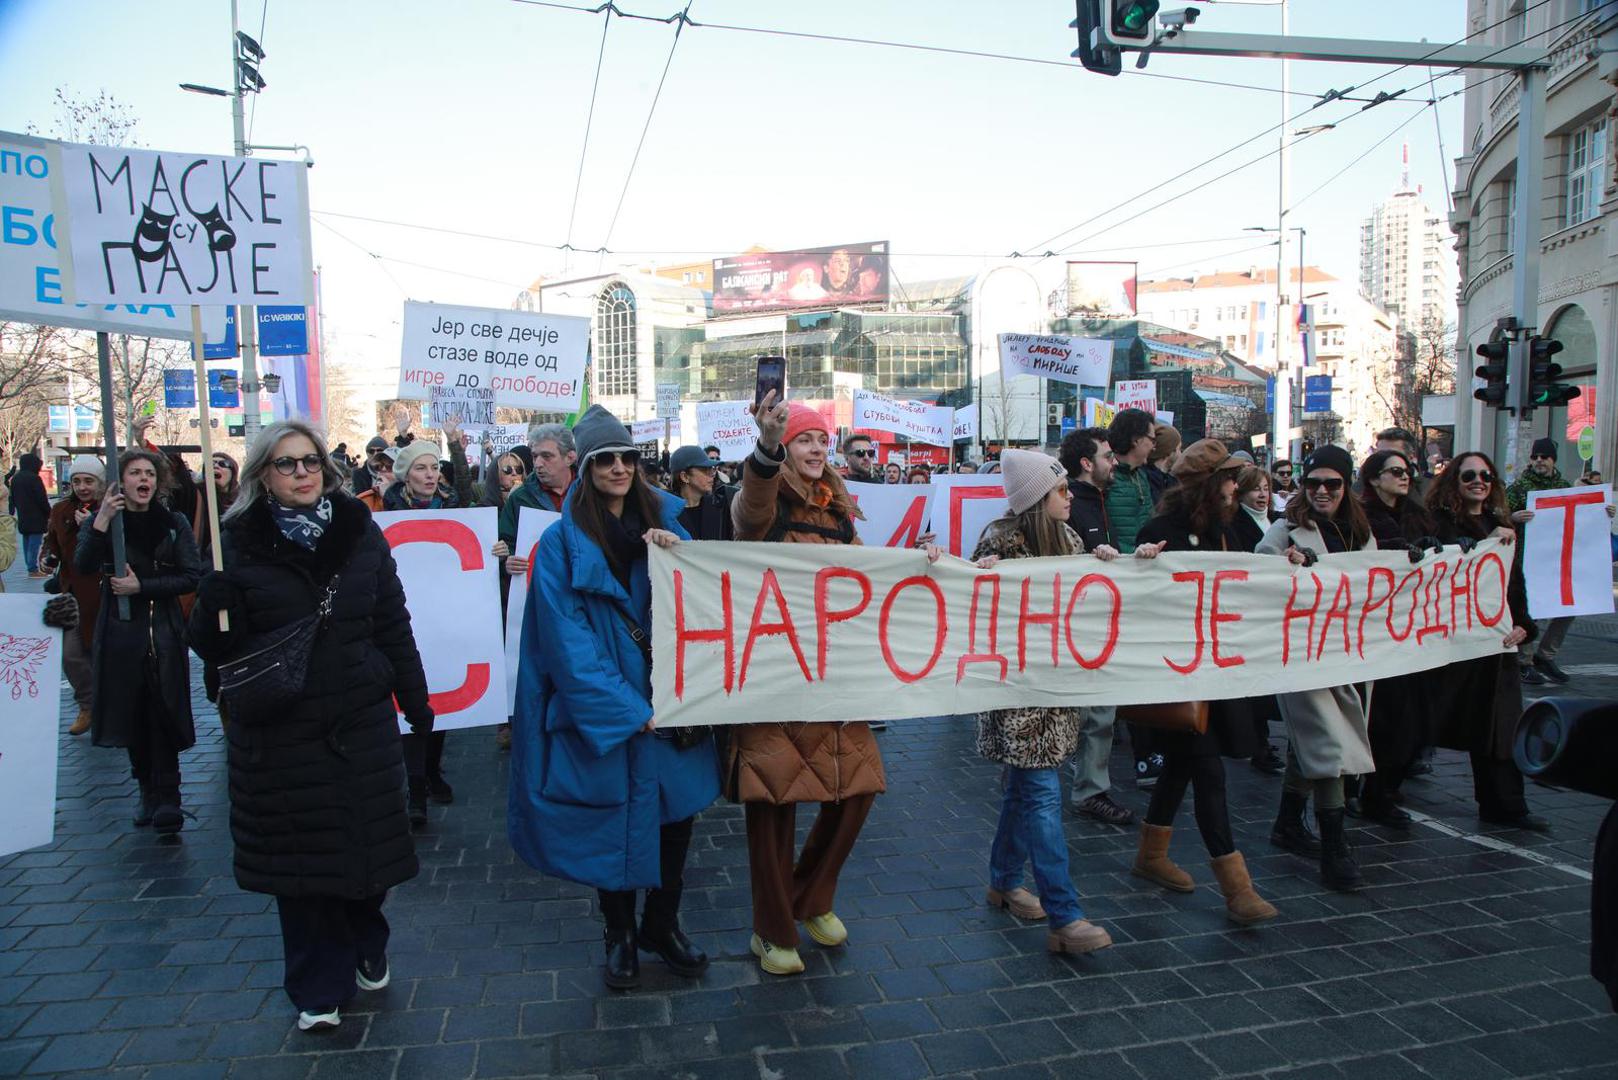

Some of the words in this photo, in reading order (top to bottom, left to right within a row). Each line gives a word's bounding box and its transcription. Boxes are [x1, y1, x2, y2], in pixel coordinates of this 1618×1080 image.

[89, 152, 282, 224] МАСКЕ
[431, 316, 465, 339] Јер
[470, 323, 503, 339] све
[507, 325, 559, 347] дечје
[427, 345, 478, 362] стазе
[484, 351, 529, 369] воде
[534, 354, 558, 372] од
[1027, 344, 1073, 362] СЛОБОДУ
[1033, 357, 1079, 376] МИРИШЕ
[405, 368, 445, 387] игре
[455, 373, 479, 388] до
[491, 376, 577, 397] слободе!
[713, 427, 752, 440] СТУДЕНТЕ
[1535, 491, 1605, 606] Т
[672, 565, 1122, 702] НАРОДНО
[1162, 570, 1249, 675] ЈЕ
[1281, 552, 1507, 668] НАРОДНО
